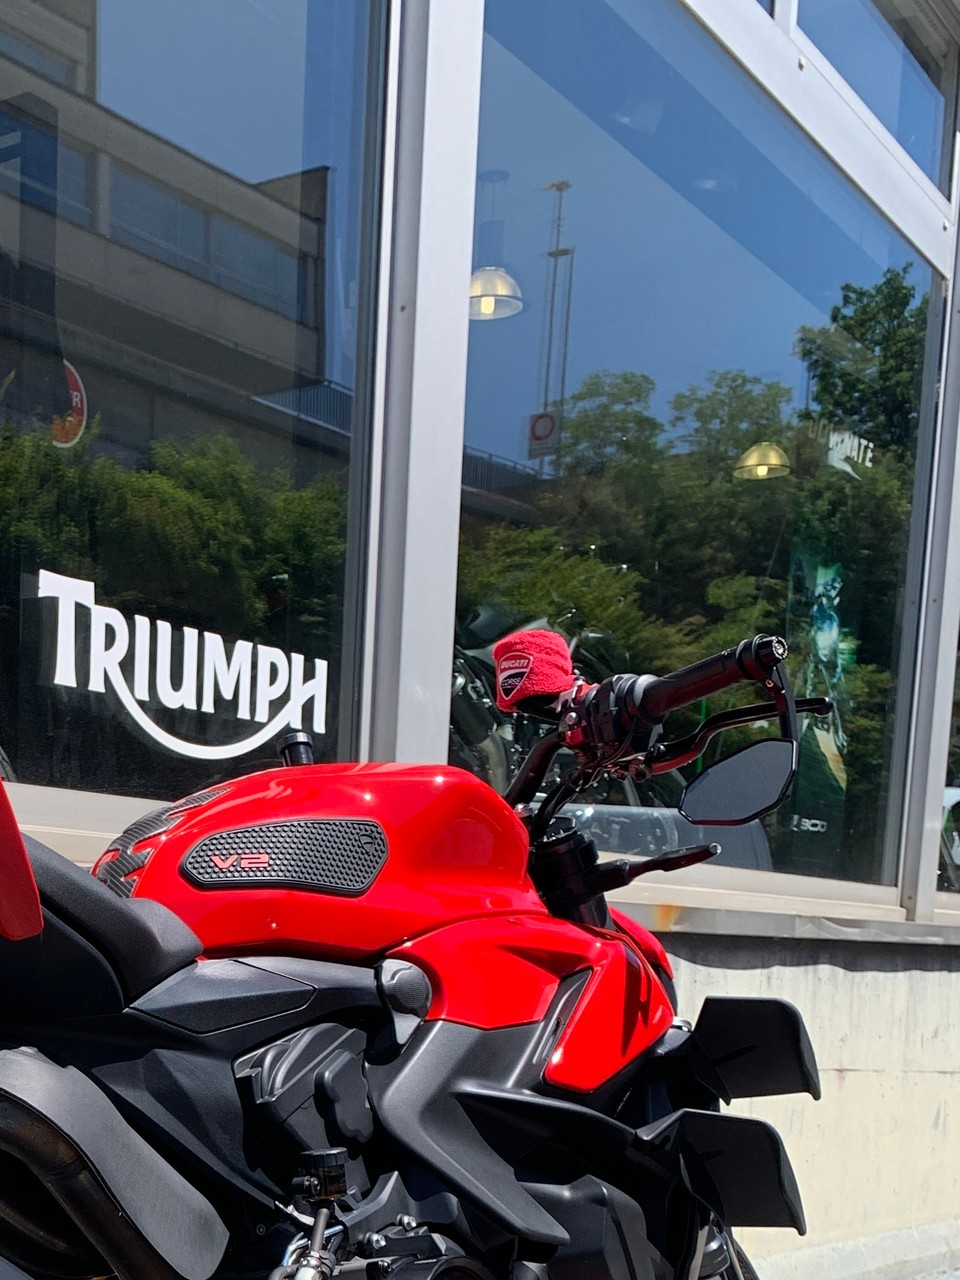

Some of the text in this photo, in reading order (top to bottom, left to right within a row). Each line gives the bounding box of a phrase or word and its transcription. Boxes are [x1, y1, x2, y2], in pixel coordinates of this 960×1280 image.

[39, 570, 329, 758] TRIUMPH
[501, 659, 529, 669] DUCATI
[210, 853, 270, 869] V2
